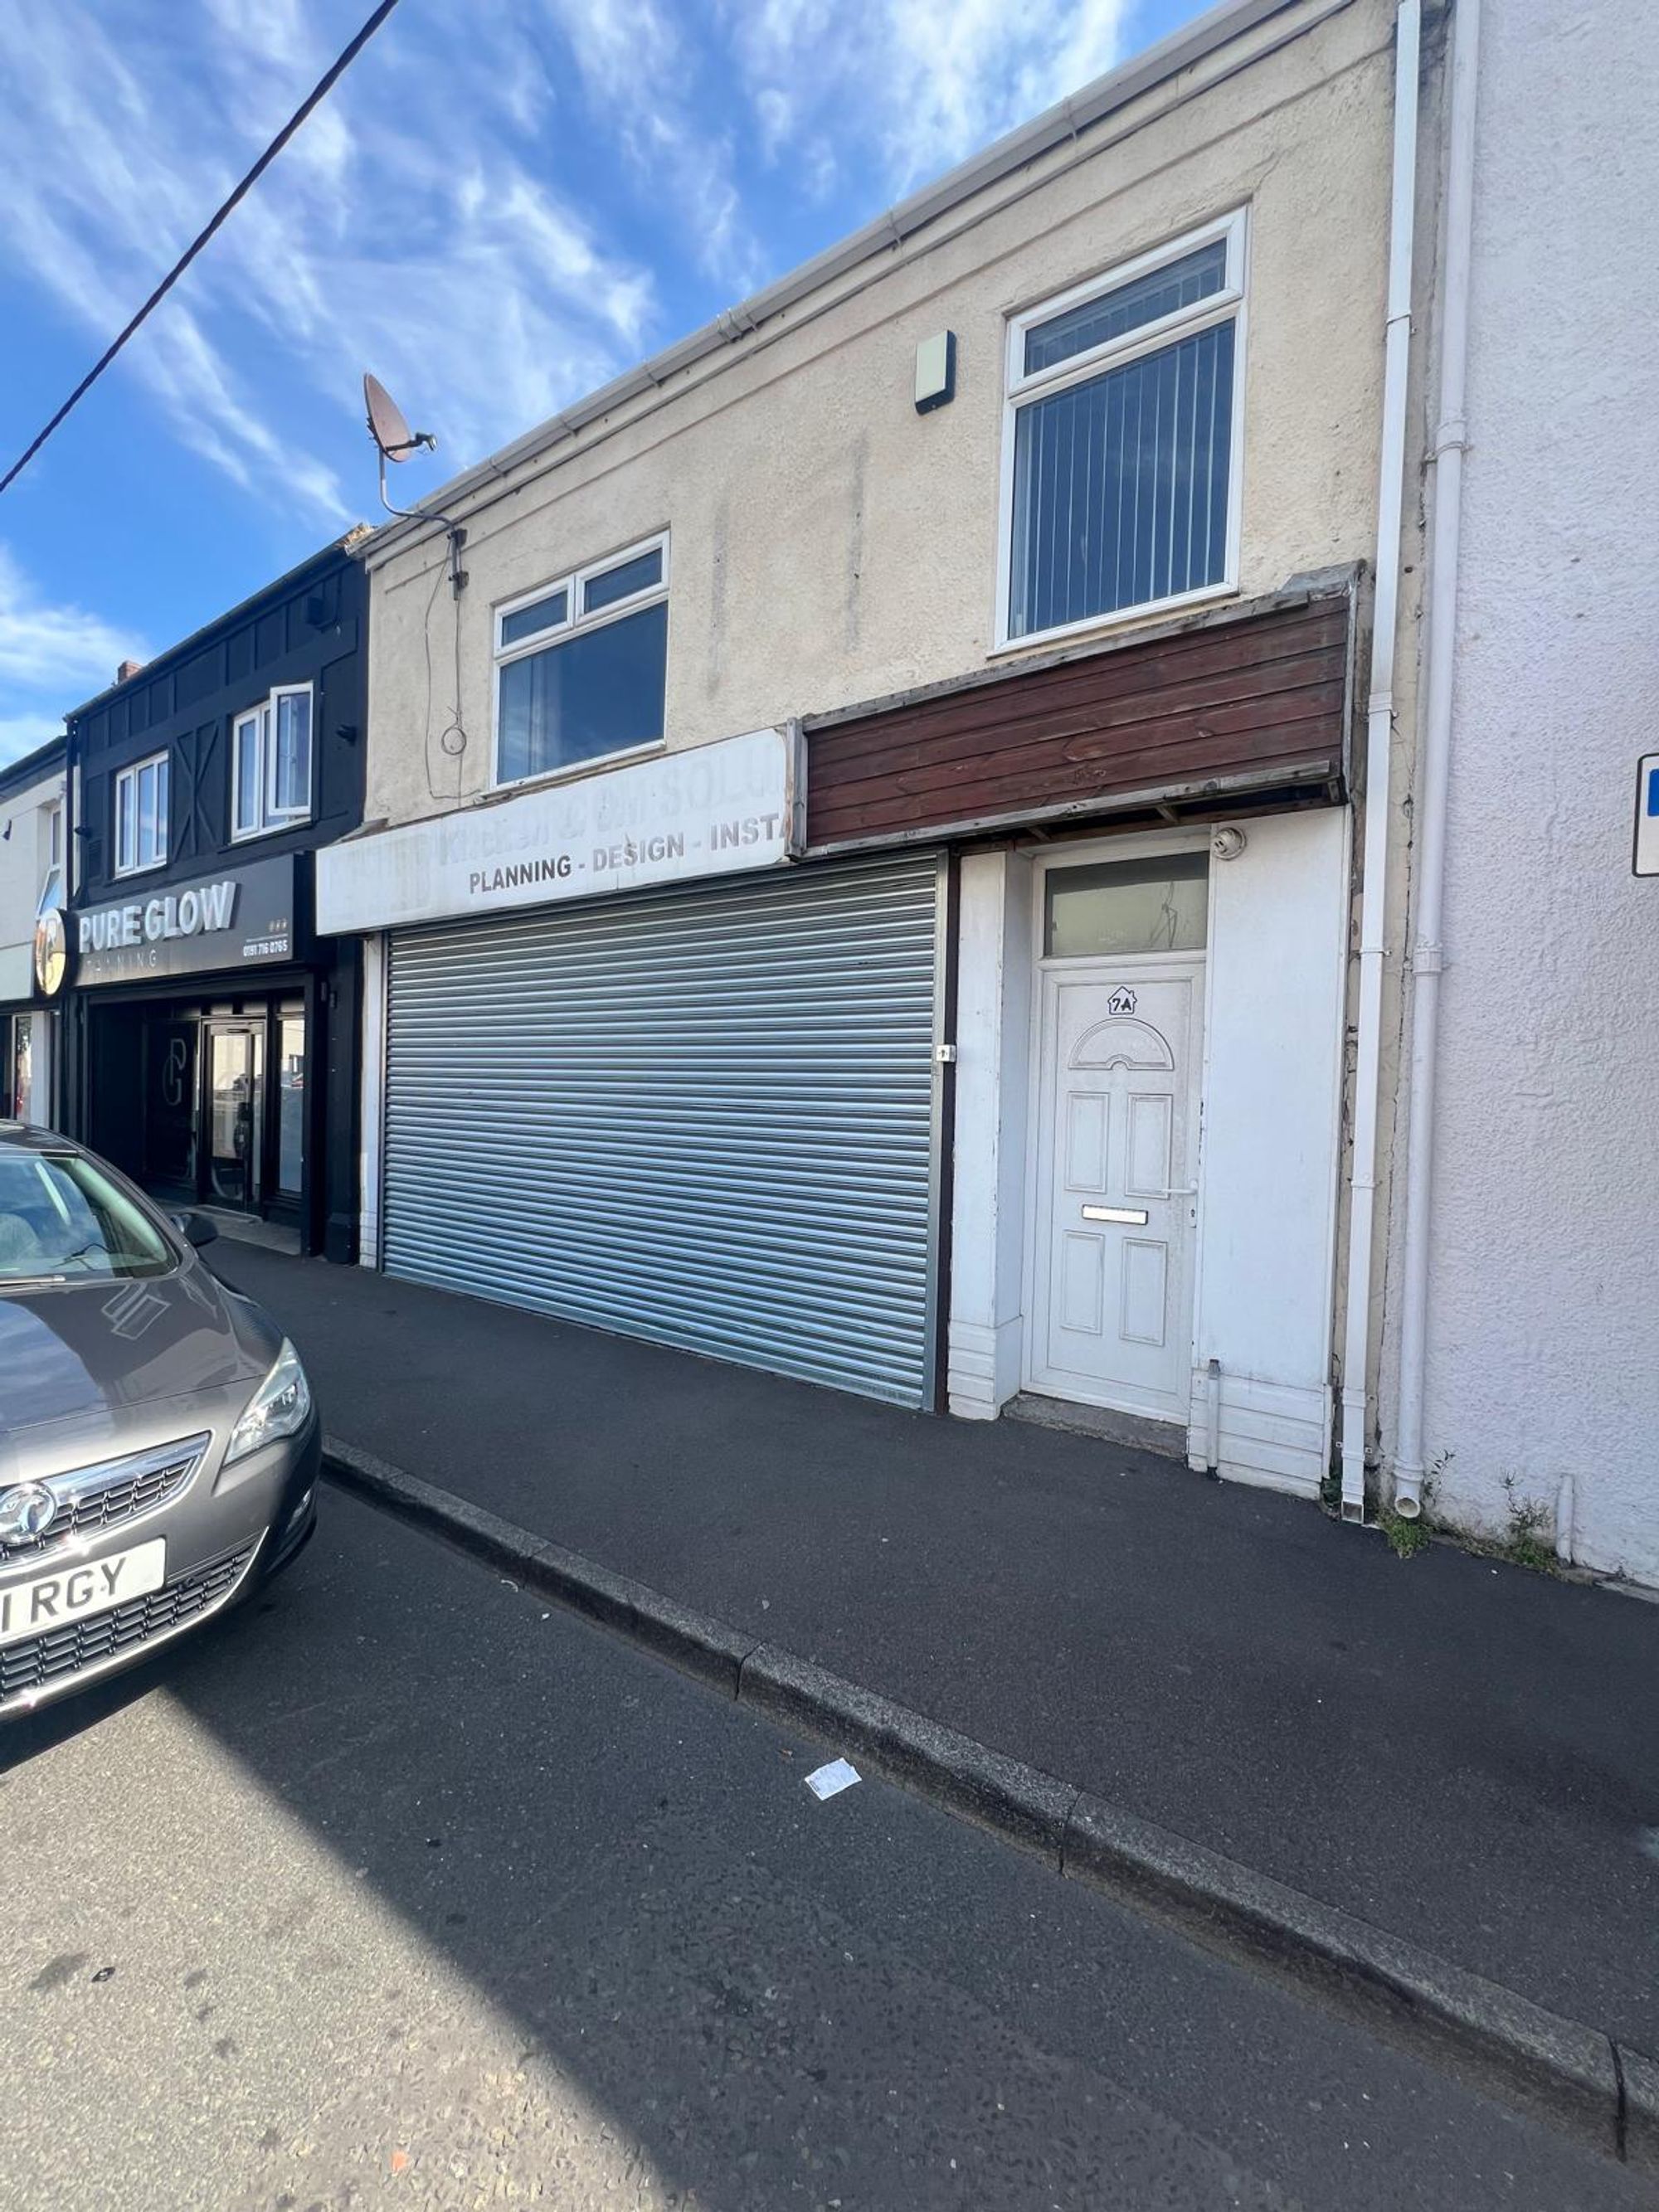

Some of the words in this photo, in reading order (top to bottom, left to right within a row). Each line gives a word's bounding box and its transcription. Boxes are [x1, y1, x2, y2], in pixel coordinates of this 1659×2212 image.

[469, 855, 572, 893] PLANNING
[592, 833, 685, 872] DESIGN
[79, 905, 142, 953] PURE
[144, 881, 236, 941] GLOW
[1112, 998, 1131, 1011] 7A
[31, 1556, 127, 1624] RGY
